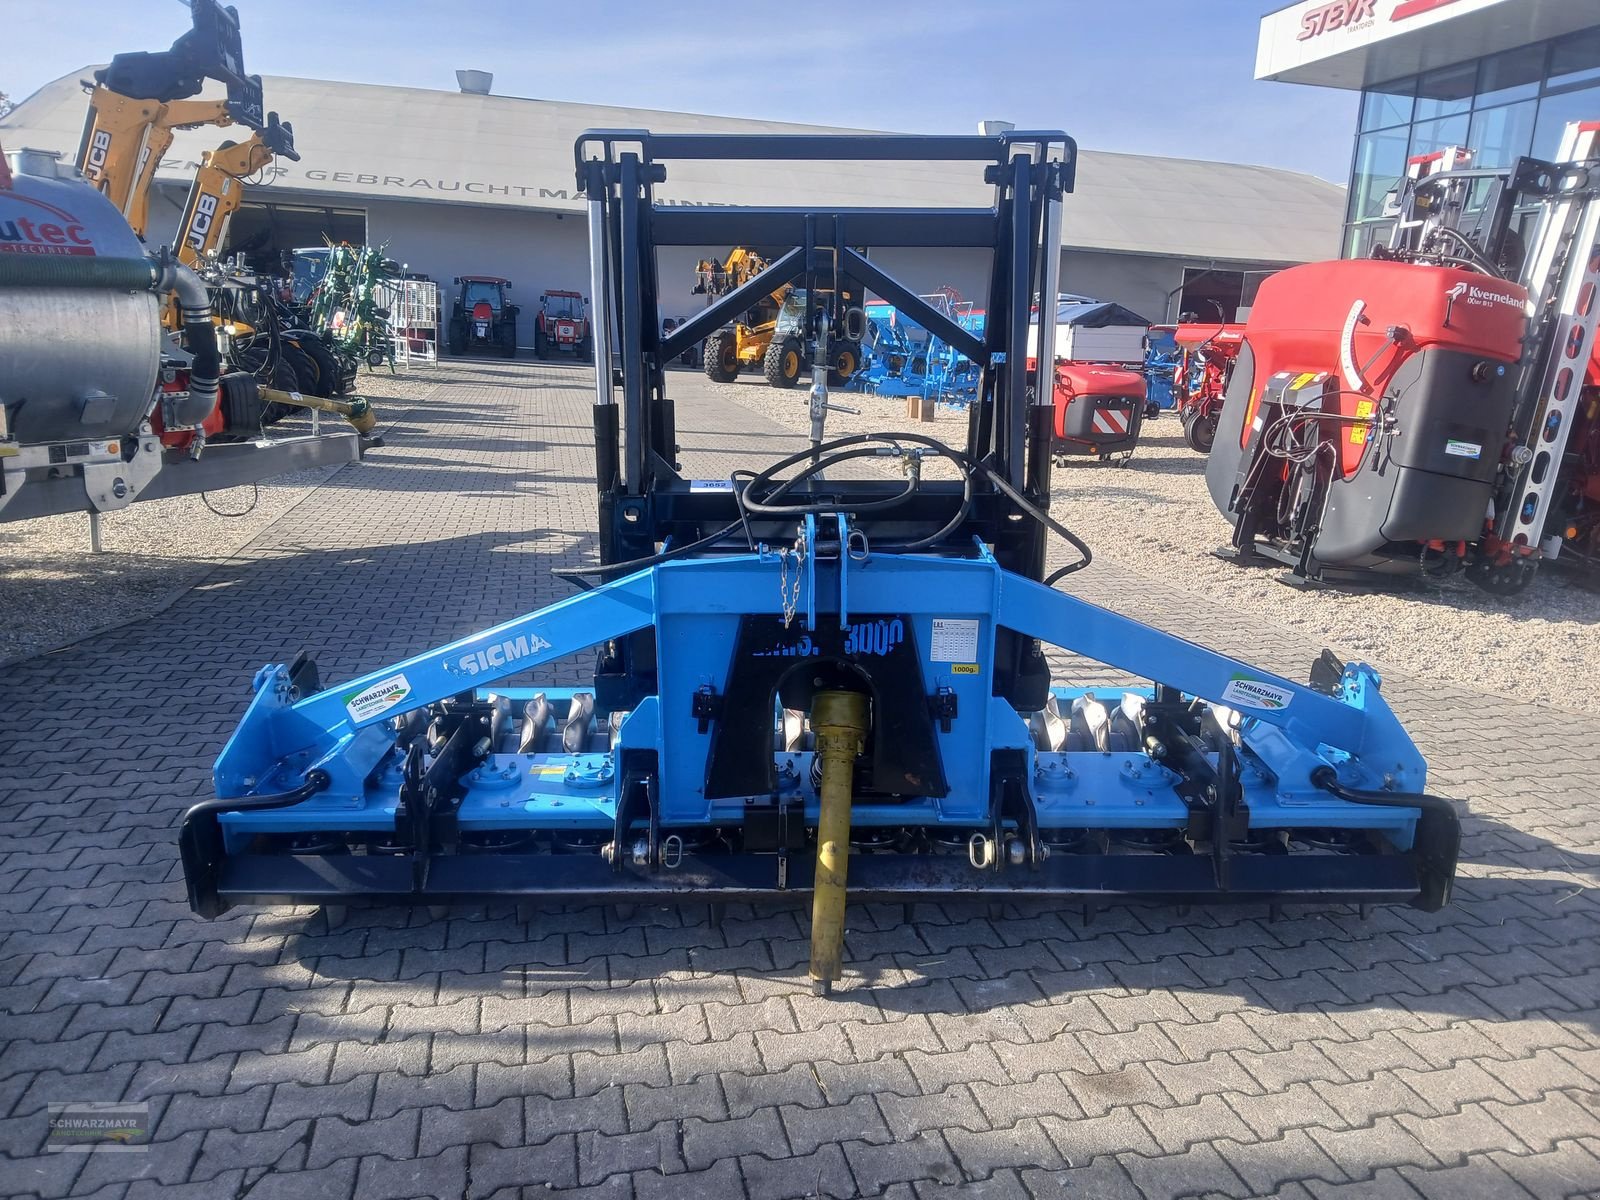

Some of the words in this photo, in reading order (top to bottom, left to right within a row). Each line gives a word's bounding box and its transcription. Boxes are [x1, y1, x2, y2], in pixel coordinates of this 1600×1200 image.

[1296, 0, 1376, 41] STEYR
[87, 130, 111, 181] JCB
[188, 193, 217, 250] JCB
[1469, 286, 1525, 310] Kverneland
[458, 633, 552, 676] SICMA
[350, 683, 400, 708] SCHWARZMAYR
[1234, 680, 1283, 701] SCHWARZMAYR
